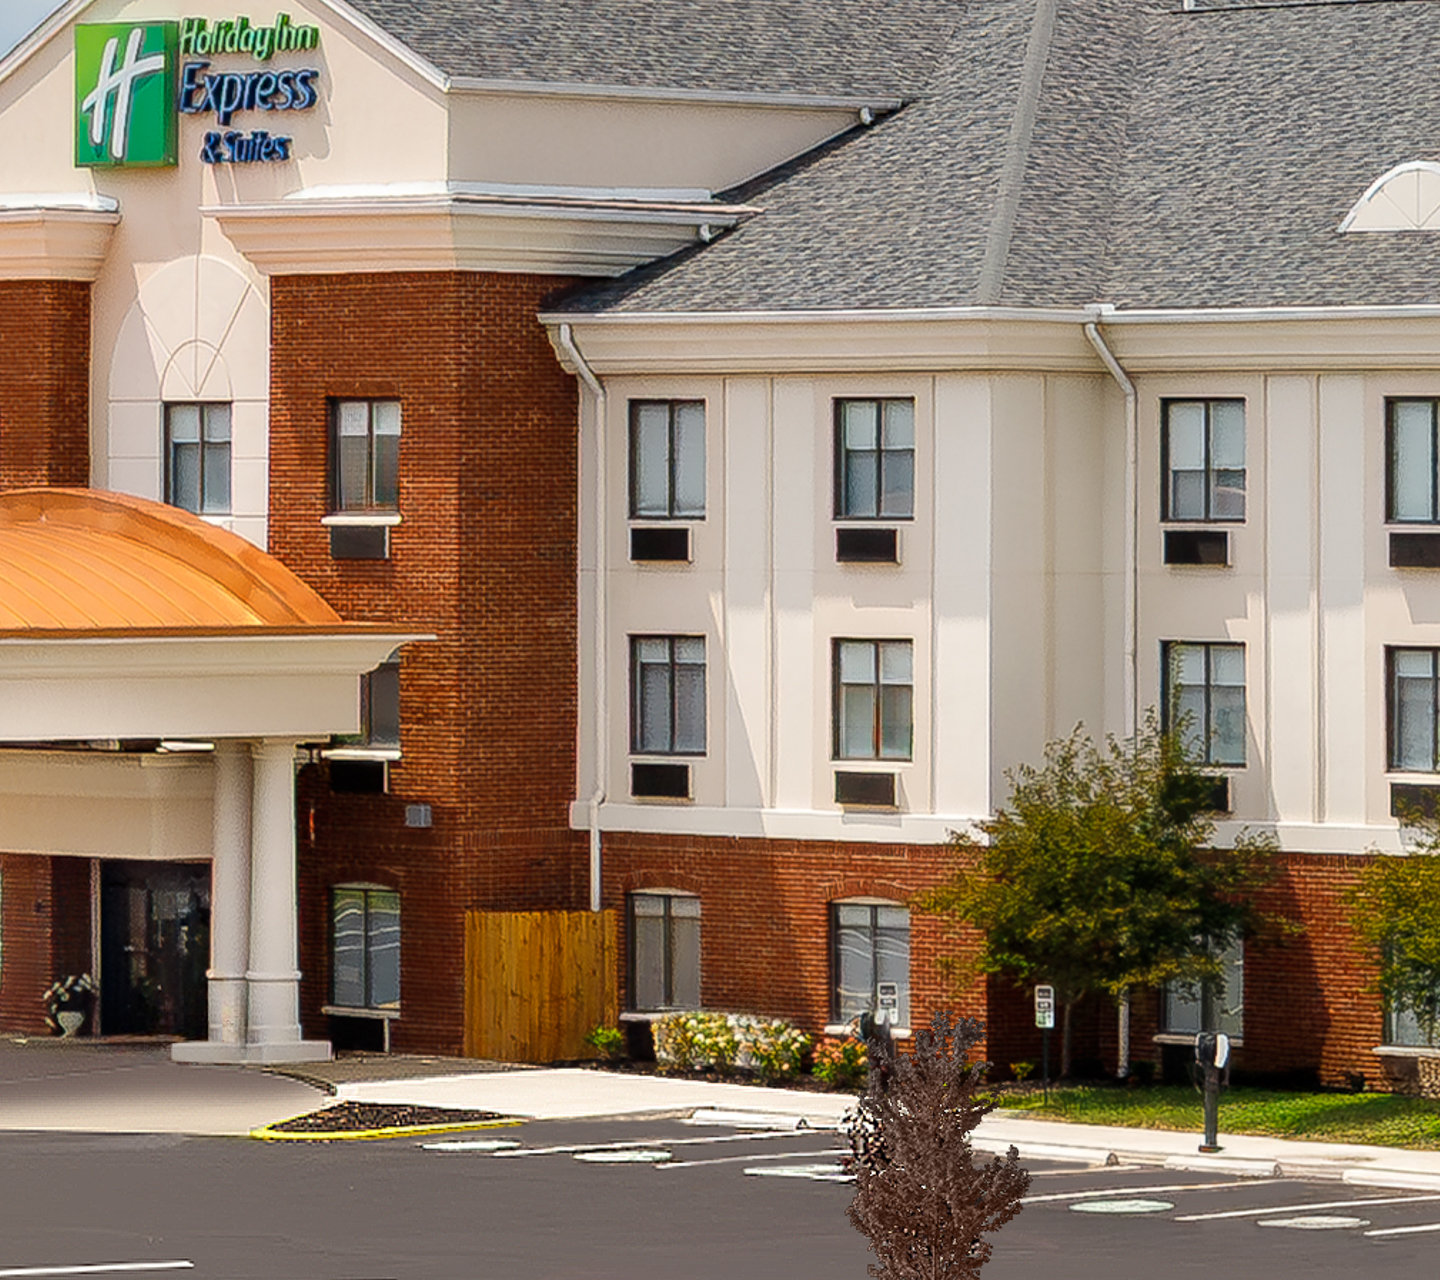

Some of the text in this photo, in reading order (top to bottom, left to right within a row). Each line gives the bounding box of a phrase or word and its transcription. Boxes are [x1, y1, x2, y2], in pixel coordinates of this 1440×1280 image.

[180, 12, 319, 60] Holiday Inn
[180, 62, 319, 126] Express
[201, 131, 292, 163] & Suites
